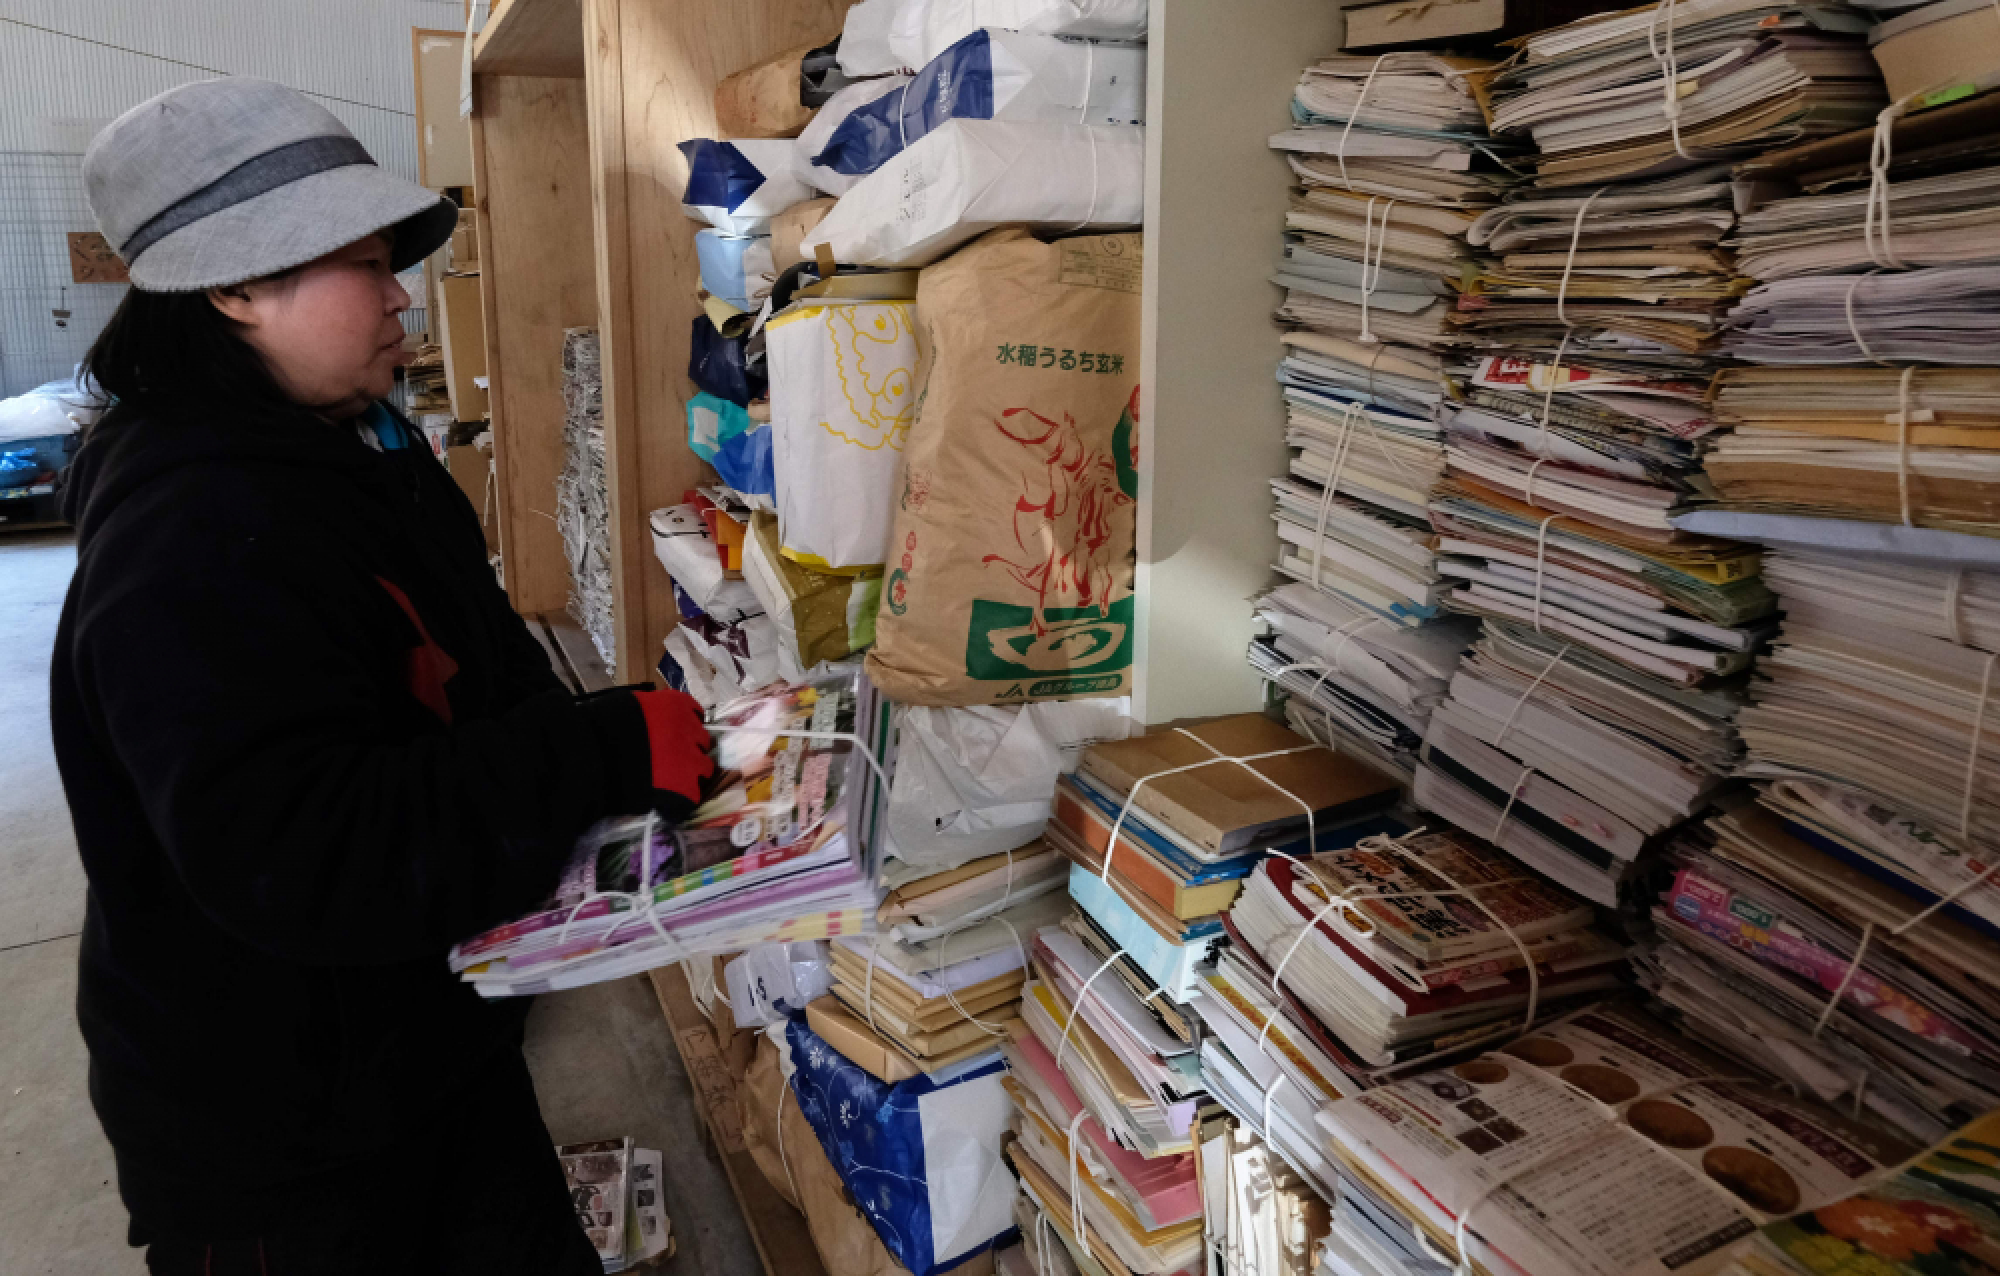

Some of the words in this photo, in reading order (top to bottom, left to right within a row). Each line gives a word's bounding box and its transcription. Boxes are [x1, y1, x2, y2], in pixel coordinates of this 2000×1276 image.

[996, 341, 1124, 376] 水稲うるち玄米
